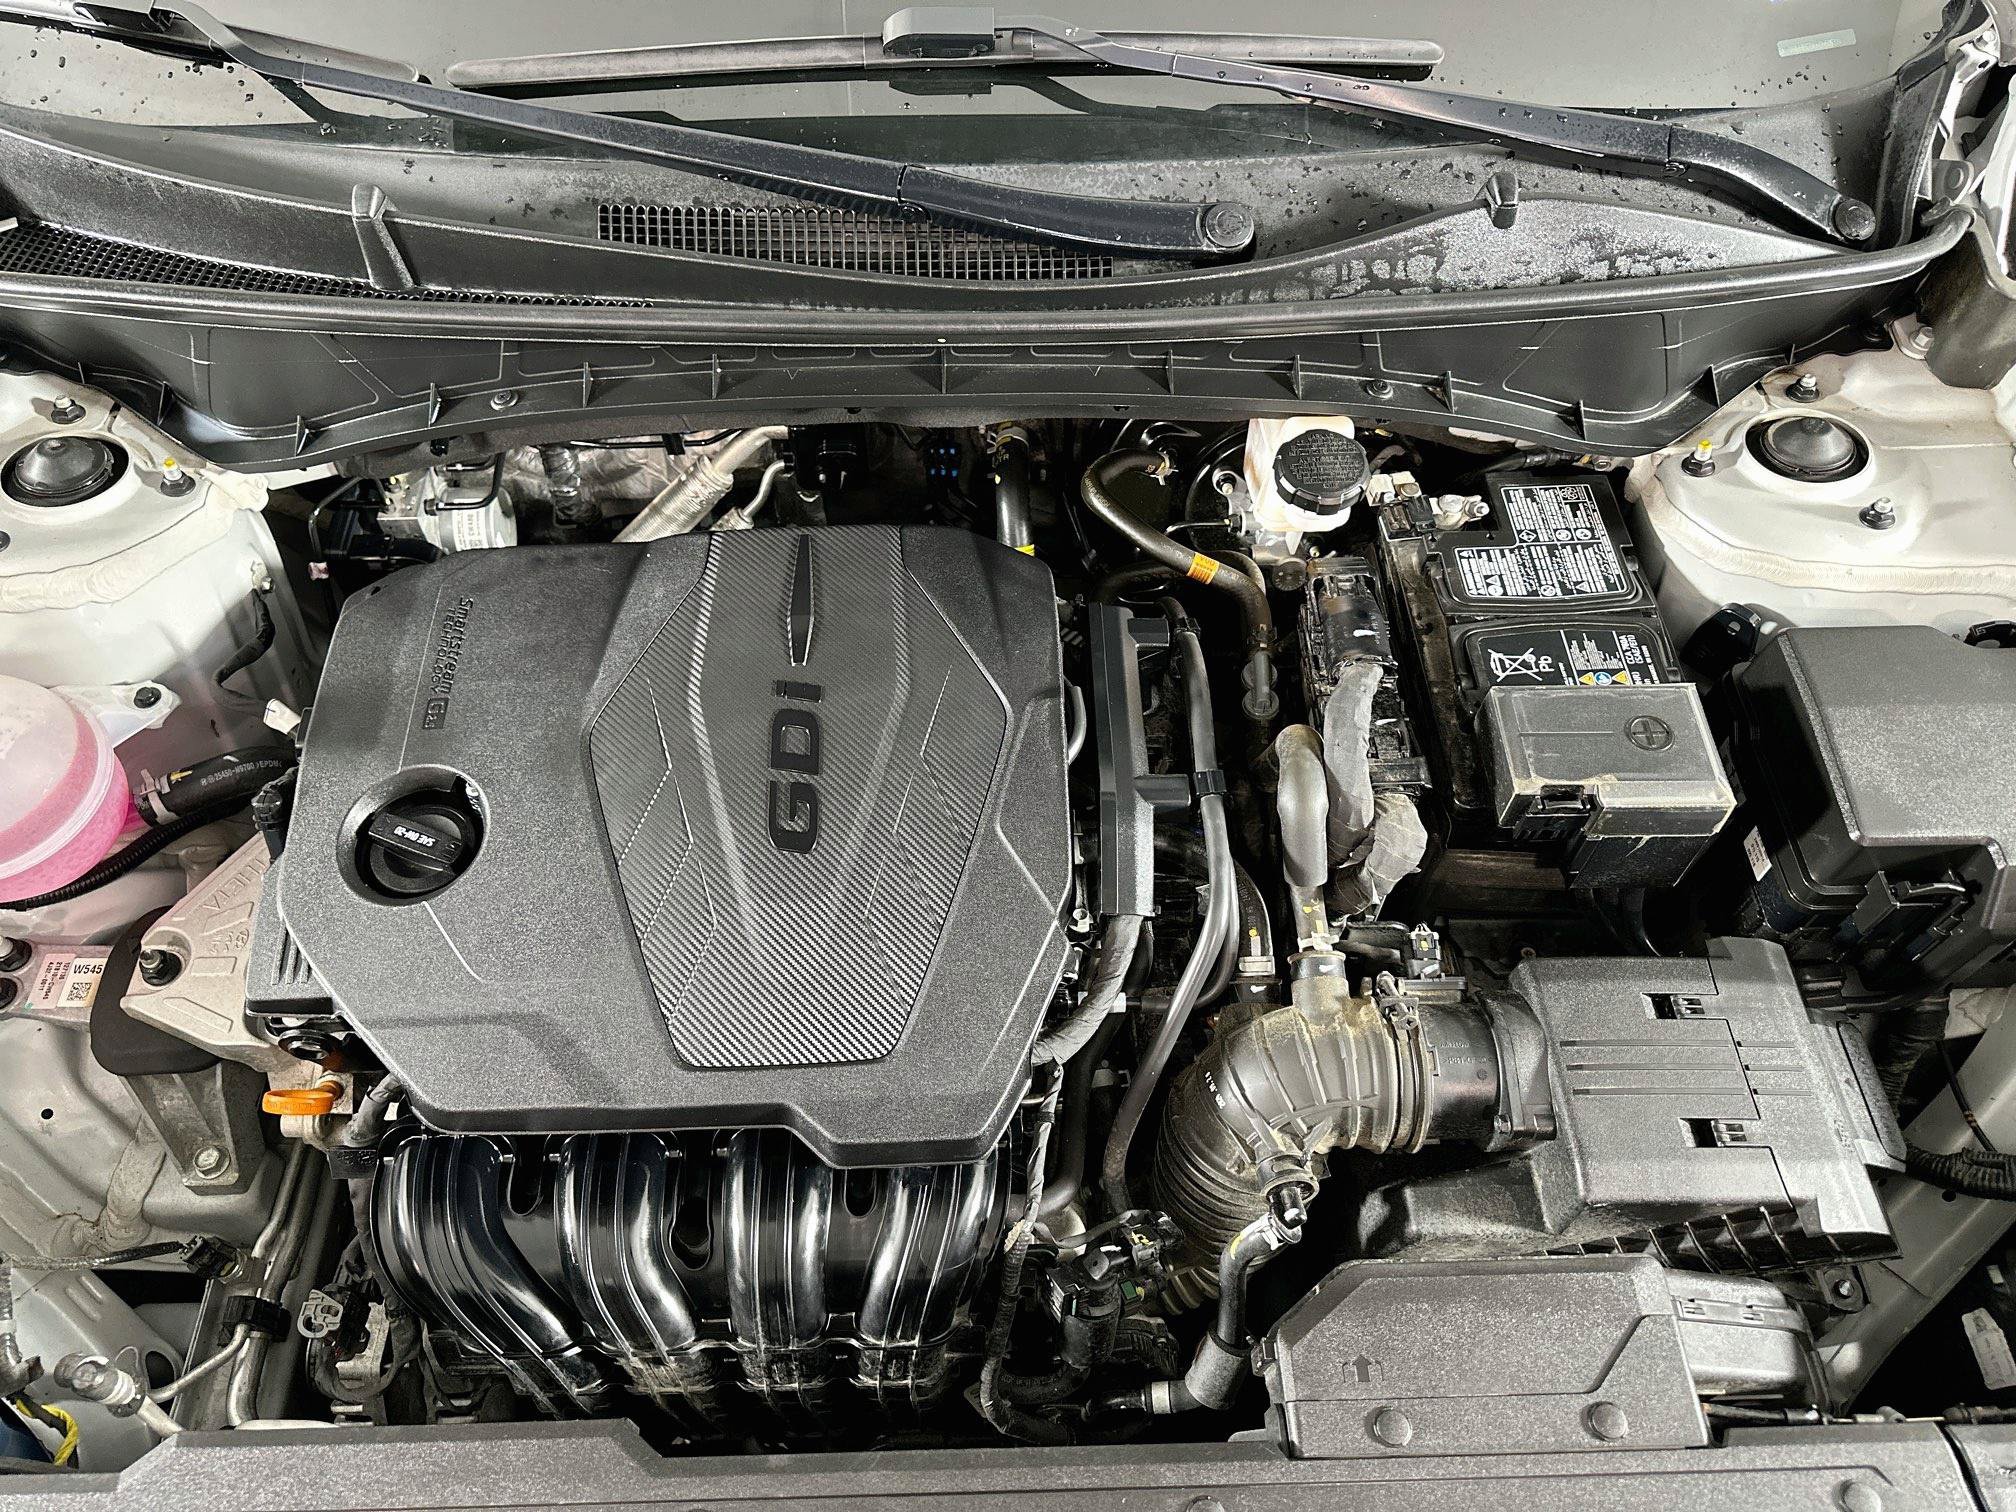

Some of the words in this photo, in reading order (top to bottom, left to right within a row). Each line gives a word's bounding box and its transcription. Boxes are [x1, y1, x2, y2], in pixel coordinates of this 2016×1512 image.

[430, 607, 456, 694] TECHNOLOGY
[440, 598, 474, 695] Smartstream
[1539, 655, 1555, 672] Pb
[1624, 651, 1635, 664] CCA
[769, 680, 822, 855] GDi
[416, 834, 436, 847] SAE
[73, 964, 104, 974] W545
